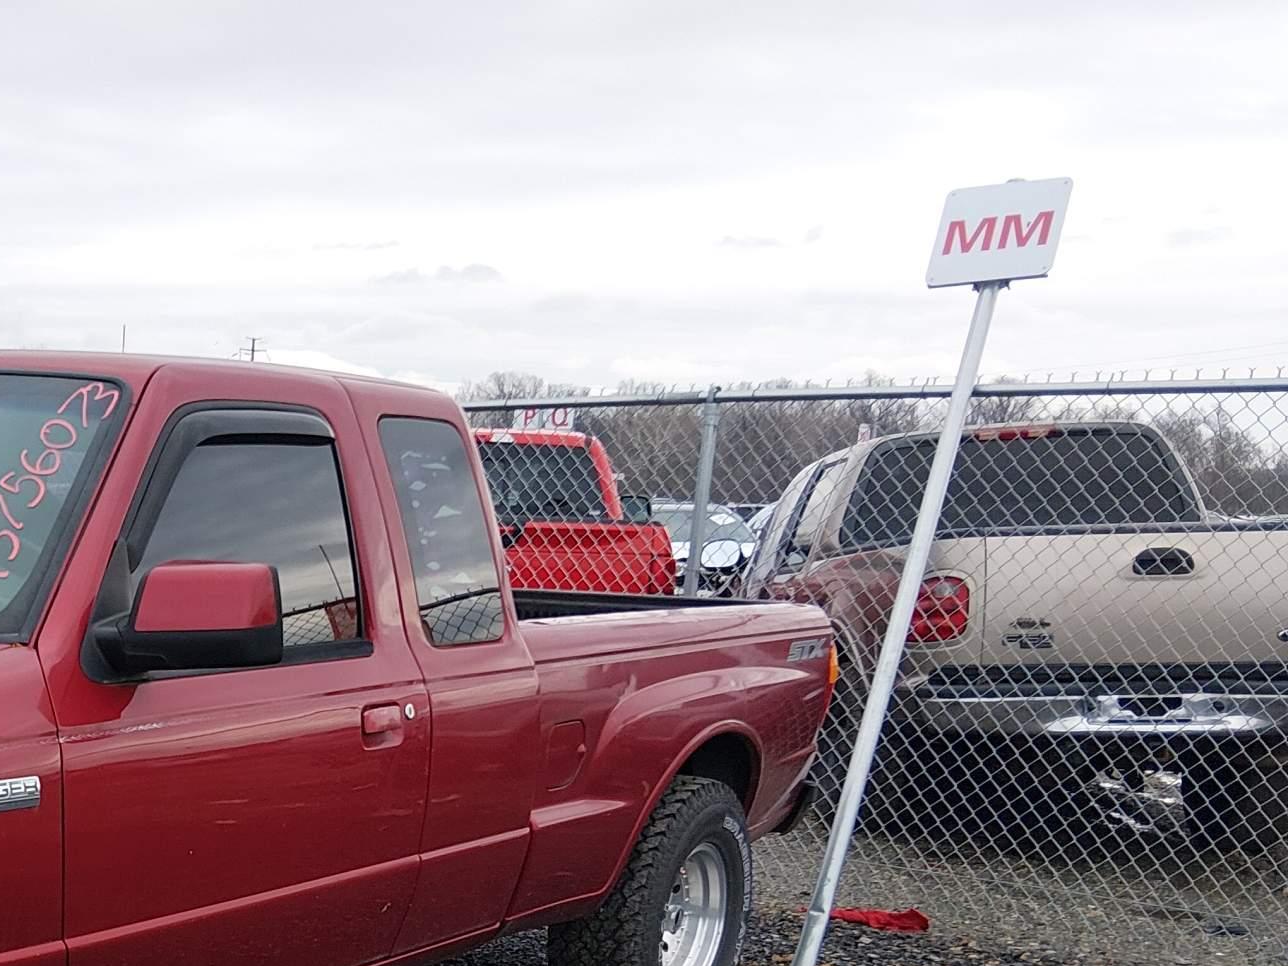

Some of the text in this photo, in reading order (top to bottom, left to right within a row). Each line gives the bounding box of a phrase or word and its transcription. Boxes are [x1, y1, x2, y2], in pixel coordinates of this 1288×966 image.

[942, 210, 1055, 256] MM
[524, 404, 536, 427] P
[552, 404, 569, 427] Q
[787, 638, 829, 662] STX
